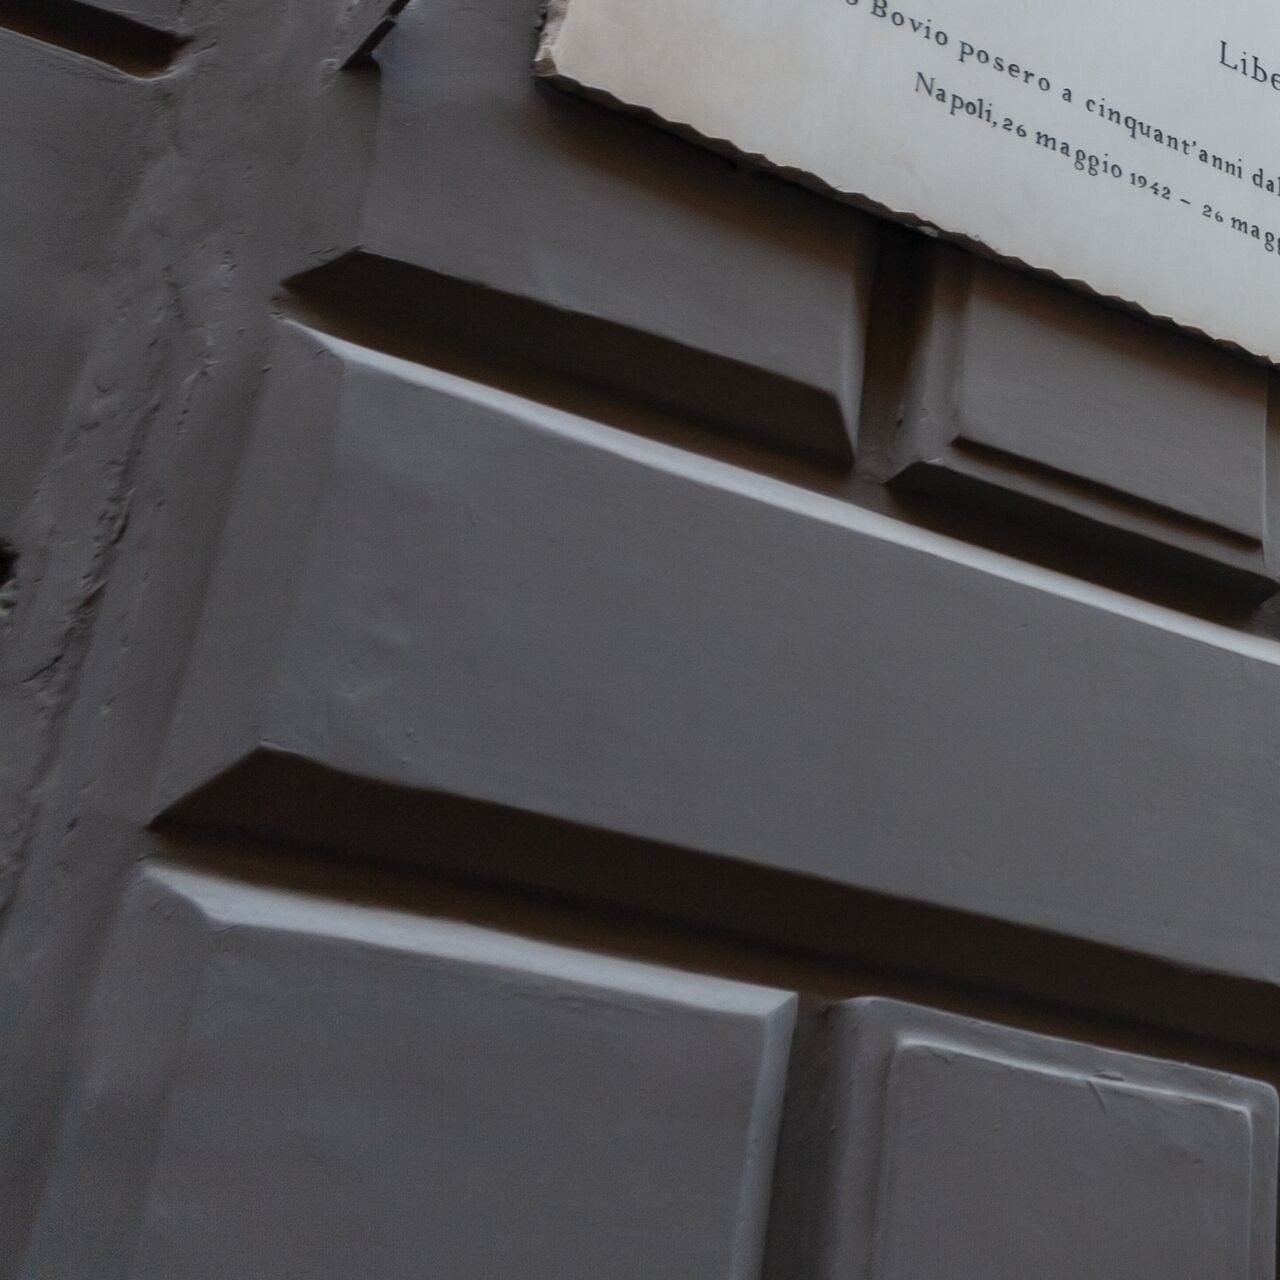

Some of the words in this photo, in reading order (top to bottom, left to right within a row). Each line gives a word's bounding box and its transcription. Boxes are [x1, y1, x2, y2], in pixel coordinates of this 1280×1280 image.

[957, 40, 1051, 92] posero
[1061, 87, 1073, 104] a
[1001, 117, 1028, 139] 26
[1034, 130, 1123, 179] maggio
[1129, 172, 1172, 201] 1942
[1201, 203, 1225, 223] 26
